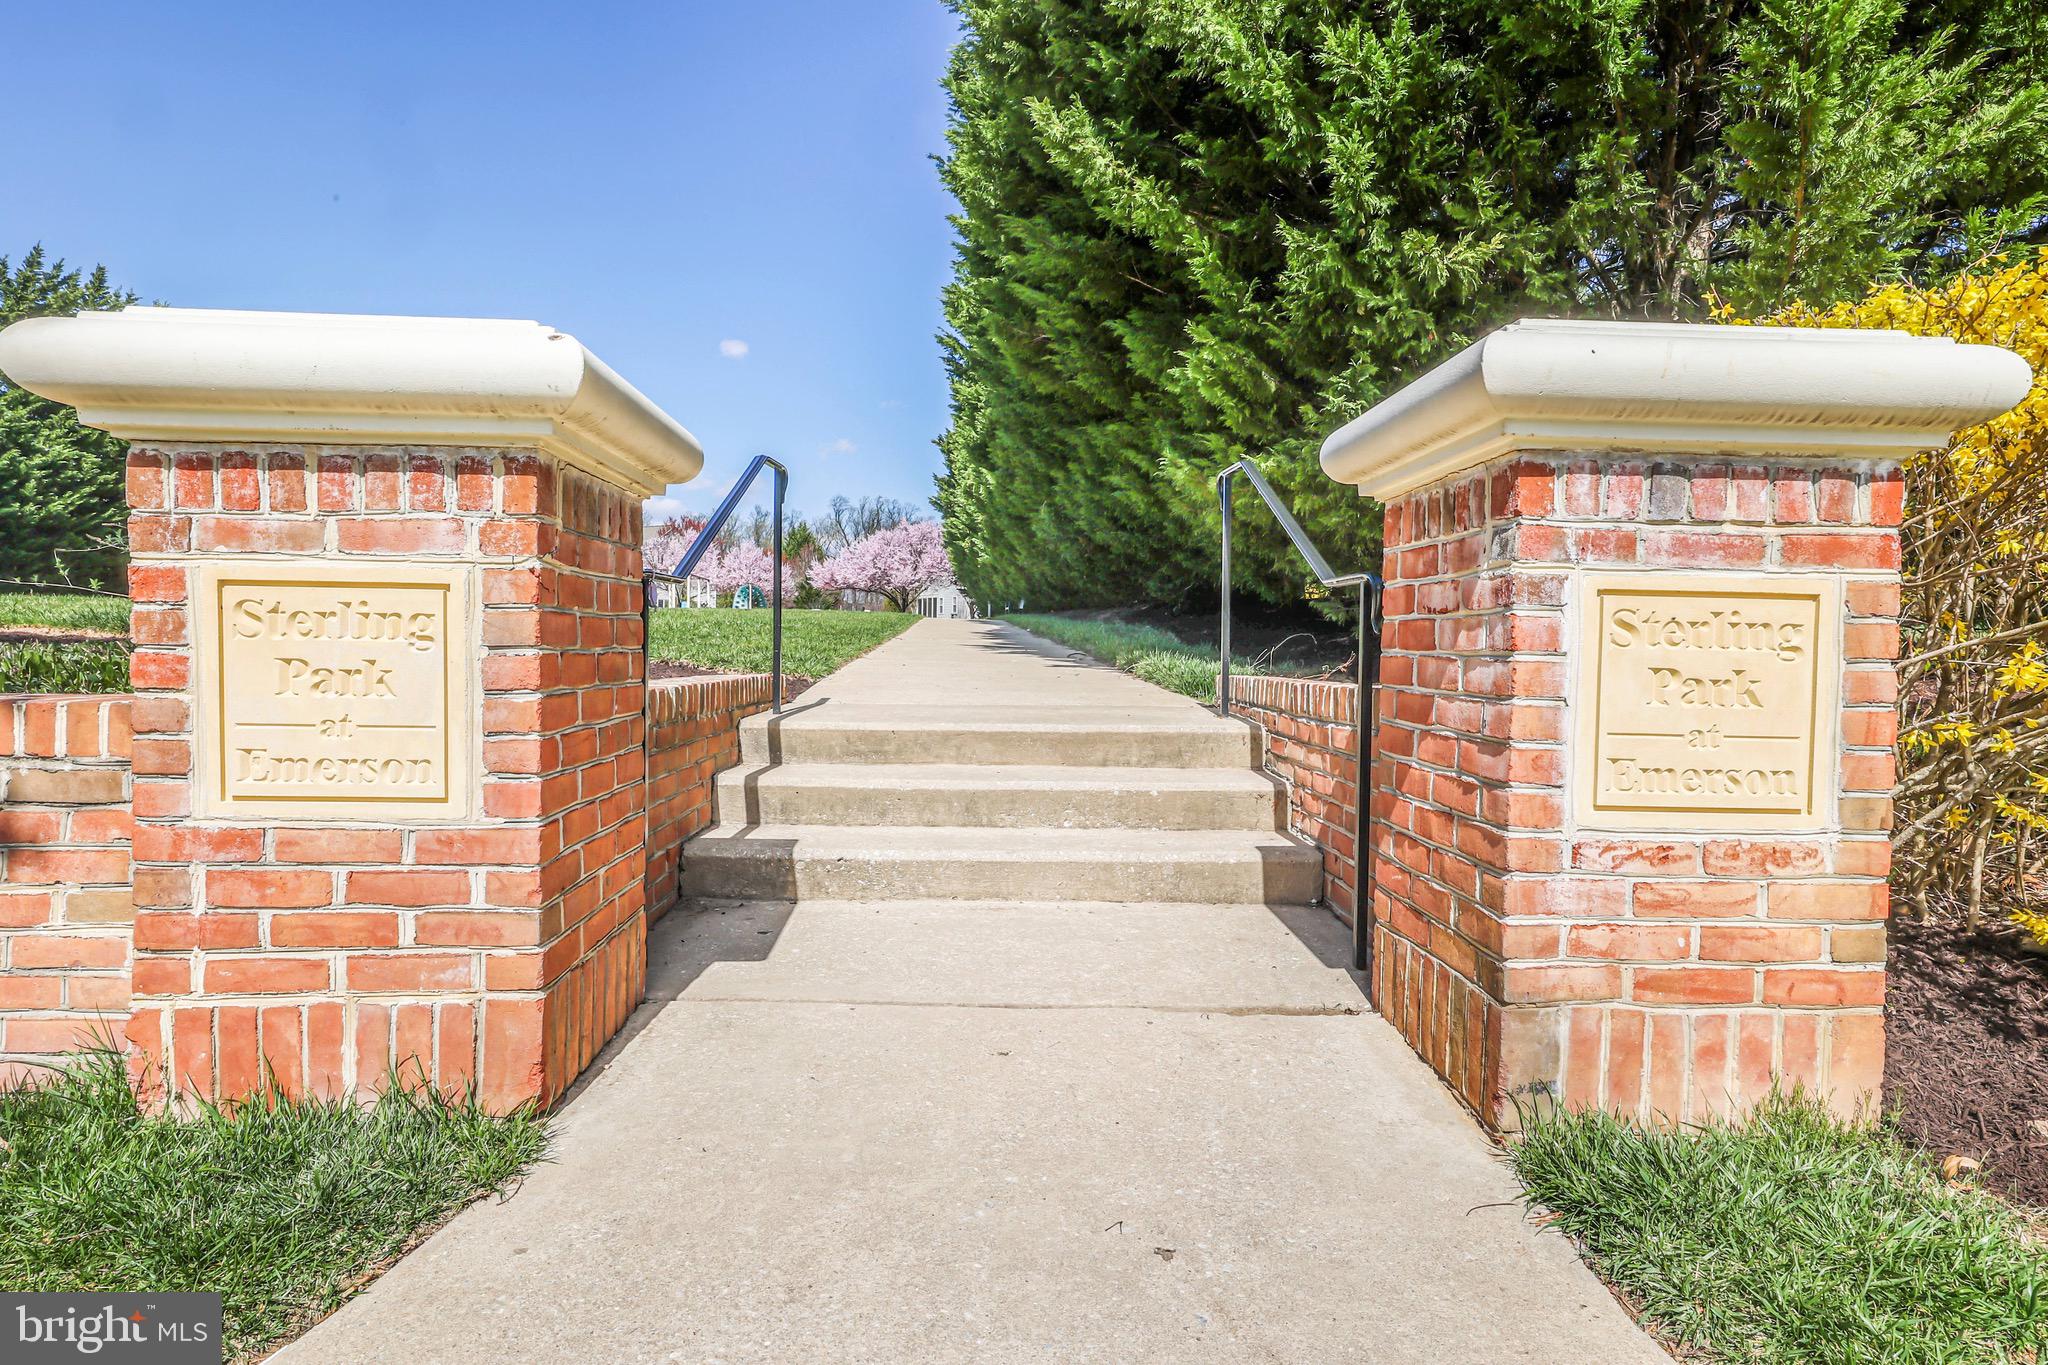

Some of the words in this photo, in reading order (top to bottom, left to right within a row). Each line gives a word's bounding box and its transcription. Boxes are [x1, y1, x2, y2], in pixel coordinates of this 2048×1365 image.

[232, 598, 436, 651] Sterling
[1609, 608, 1804, 662] Sterling
[273, 657, 398, 697] Park
[1646, 667, 1764, 708] Park
[319, 713, 354, 738] at
[1687, 724, 1720, 748] at
[235, 748, 437, 785] Emerson
[1605, 757, 1798, 796] Emerson
